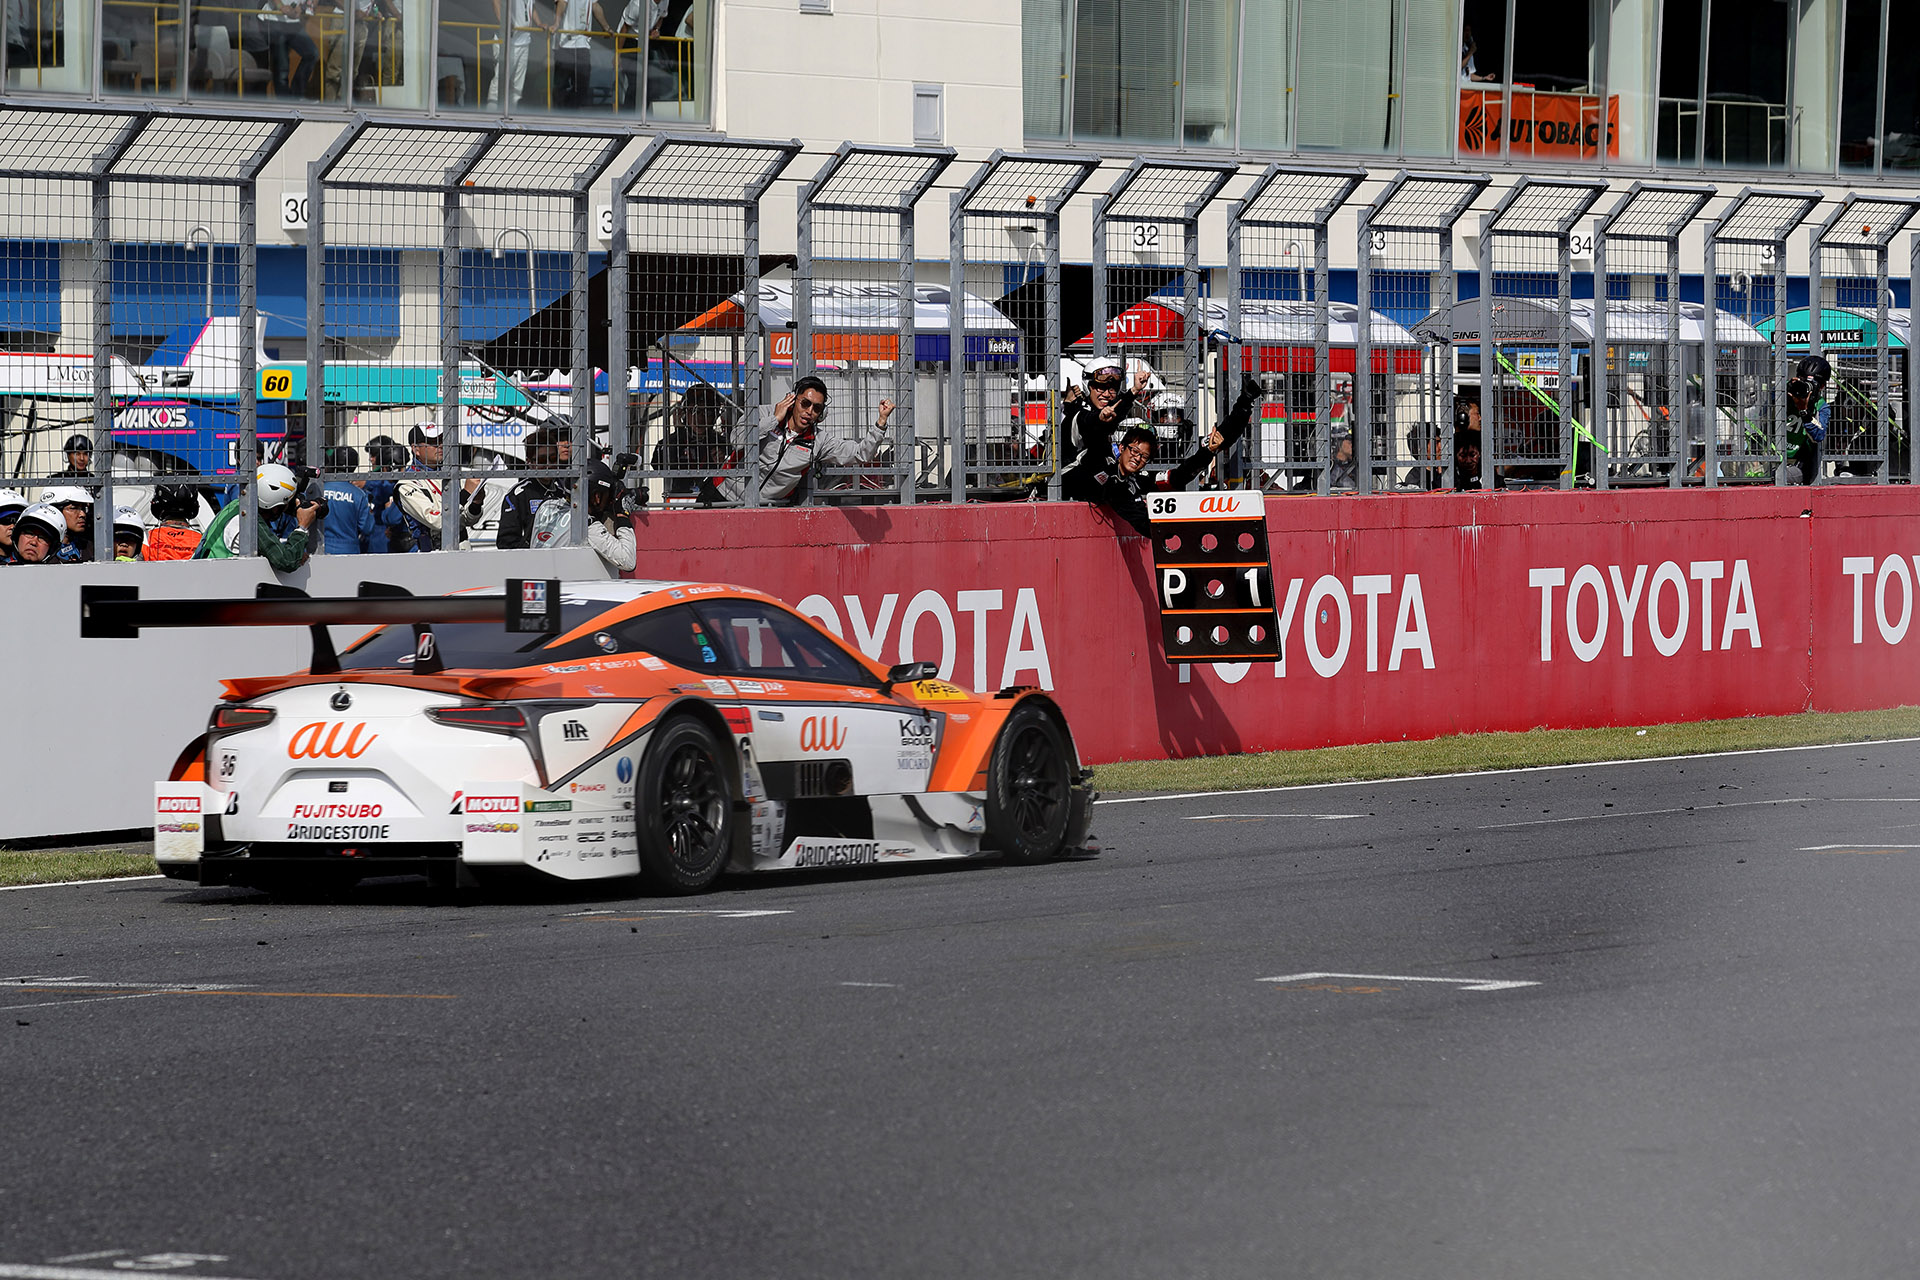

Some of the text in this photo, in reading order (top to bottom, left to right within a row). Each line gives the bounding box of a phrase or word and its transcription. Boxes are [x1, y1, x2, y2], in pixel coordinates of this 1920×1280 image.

[1490, 118, 1613, 147] AUTOBACS
[1134, 225, 1158, 246] 32
[1571, 235, 1593, 254] 34
[1107, 314, 1140, 333] ENT
[1826, 332, 1860, 341] MILLE
[265, 376, 289, 392] 60
[466, 423, 523, 438] KOBELCO
[323, 490, 355, 503] FFICIAL
[1152, 496, 1240, 514] 36 au
[1163, 568, 1262, 608] P 1
[1842, 553, 1920, 645] TO
[1529, 559, 1762, 662] TOYOTA
[1177, 573, 1435, 684] YOTA
[287, 721, 378, 760] au
[800, 715, 848, 752] au
[901, 738, 933, 746] GROUP
[220, 755, 237, 777] 36
[160, 798, 200, 811] MOTUL
[293, 804, 382, 818] FUJITSUBO
[467, 798, 518, 811] MOTUL
[288, 823, 390, 840] BRIDGESTONE
[795, 842, 880, 867] BRIDGESTONE
